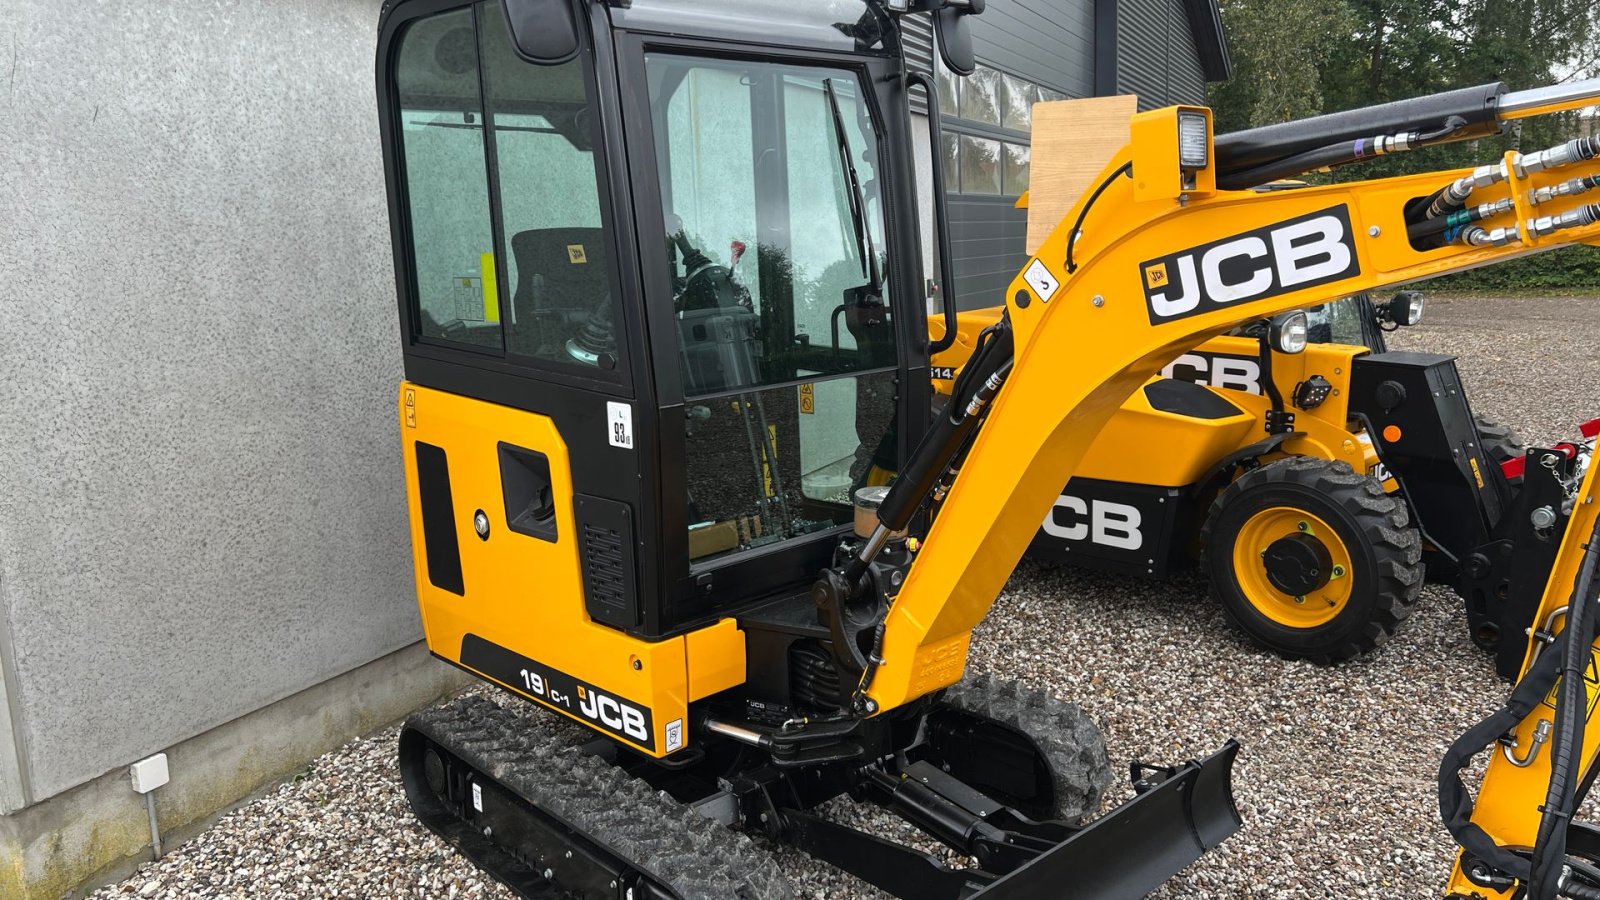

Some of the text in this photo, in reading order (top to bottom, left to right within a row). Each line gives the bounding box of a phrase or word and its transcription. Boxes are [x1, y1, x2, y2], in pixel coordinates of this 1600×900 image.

[1150, 215, 1351, 317] JCB
[1161, 354, 1260, 396] CB
[614, 421, 625, 444] 93
[1042, 494, 1142, 551] CB
[520, 668, 545, 696] 19
[579, 689, 648, 742] JCB
